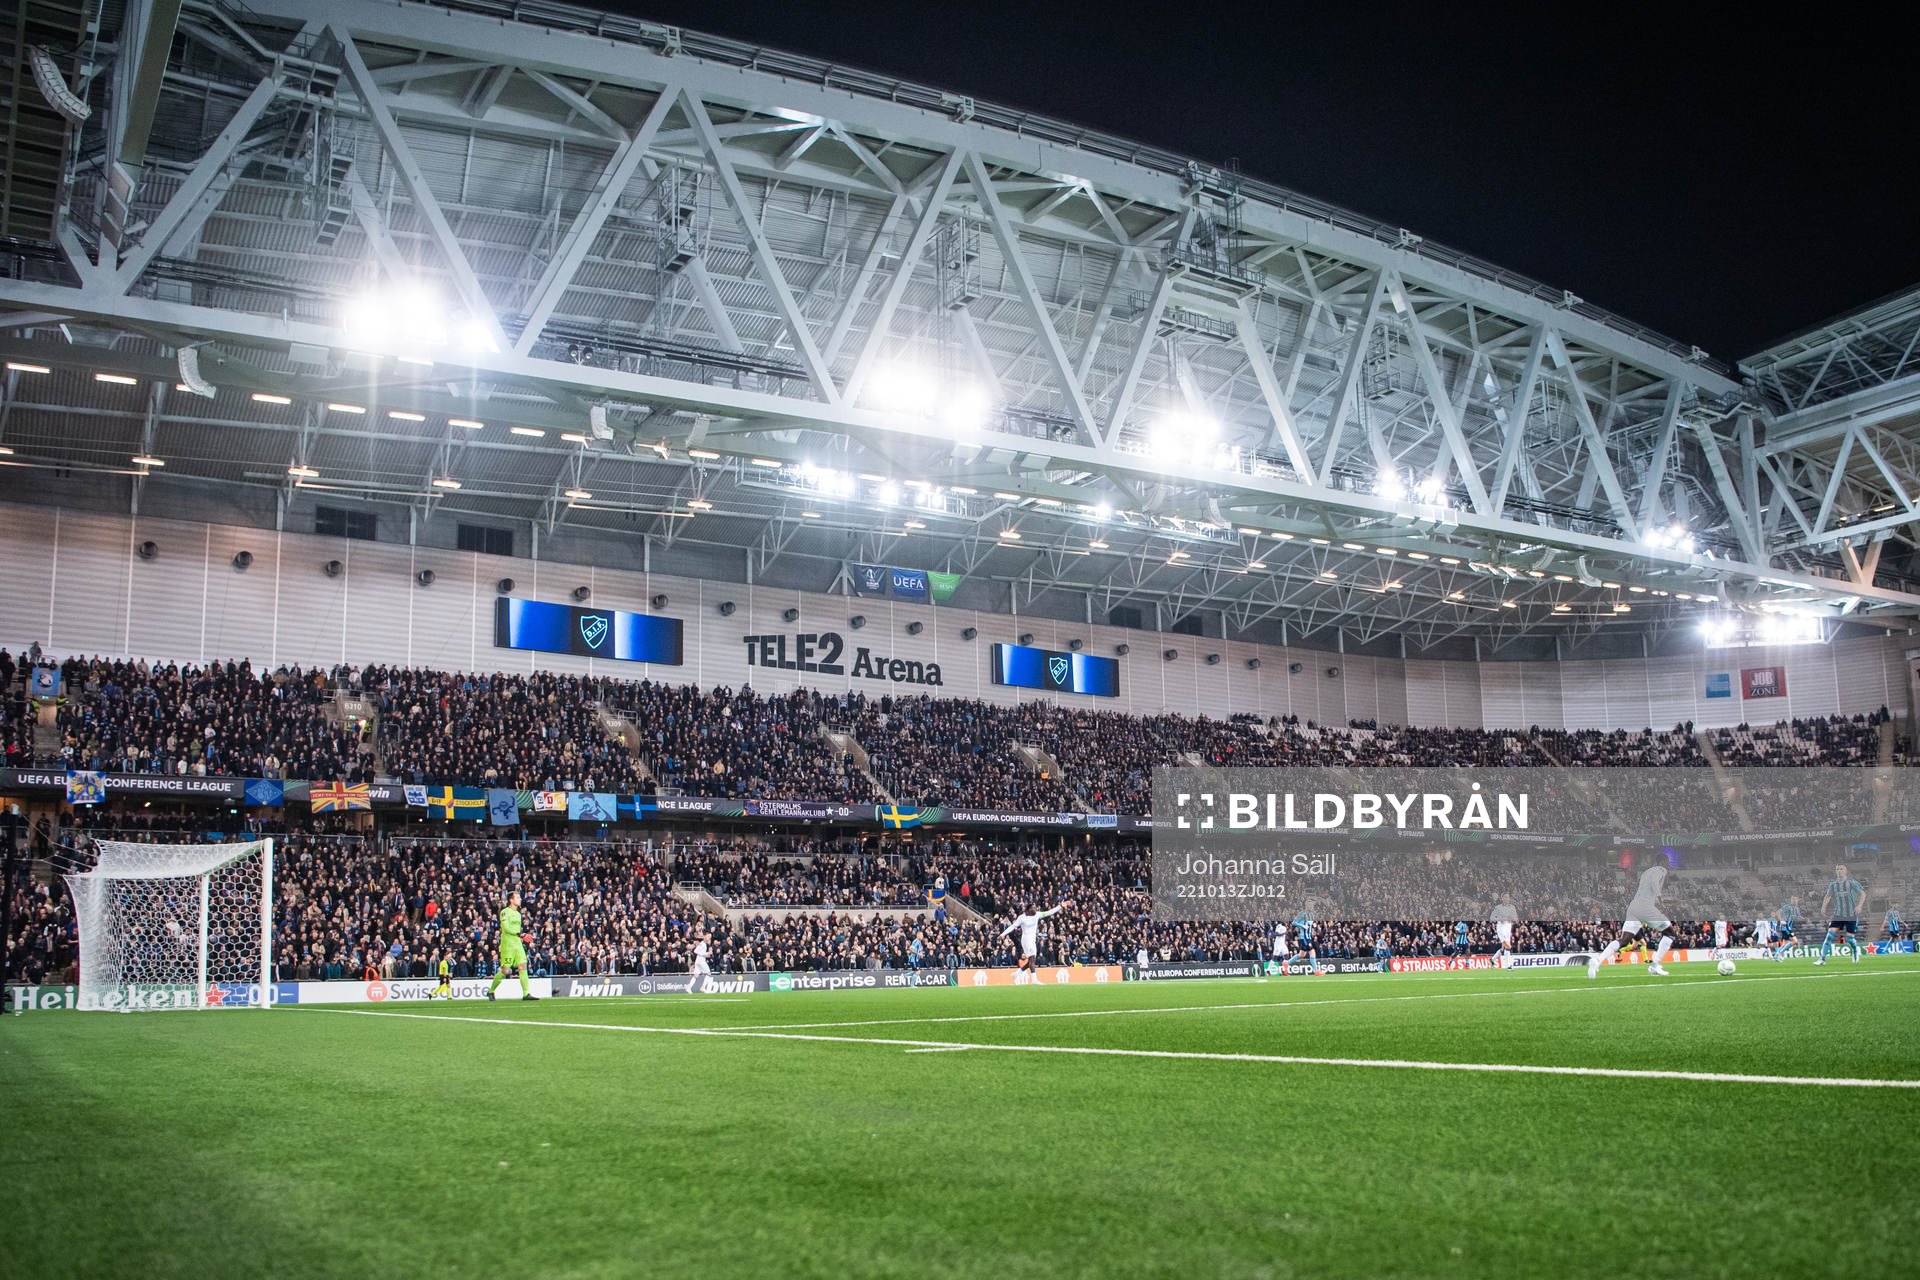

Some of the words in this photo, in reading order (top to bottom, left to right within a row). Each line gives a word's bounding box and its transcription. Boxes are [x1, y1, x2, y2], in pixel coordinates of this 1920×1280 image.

[893, 576, 924, 589] UEFA
[743, 632, 844, 675] TELE2
[851, 648, 943, 686] Arena
[1751, 686, 1777, 697] ZONE
[18, 774, 51, 785] UEFA
[104, 778, 183, 790] CONFERENCE
[187, 781, 232, 792] LEAGUE
[368, 787, 390, 798] win
[678, 802, 712, 810] LEAGUE
[1000, 814, 1045, 823] CONFERENCE
[1764, 832, 1807, 840] CONFERENCE
[1341, 963, 1380, 973] RENT-A-CA
[1402, 959, 1447, 972] STRAUSS
[1158, 969, 1183, 977] EUROPA
[1184, 968, 1224, 976] CONFERENCE
[1225, 967, 1249, 975] LEAGUE
[772, 973, 876, 990] enterprise
[885, 974, 947, 986] RENTA-CAR
[390, 983, 490, 1000] Swissuote
[569, 978, 623, 997] bwin
